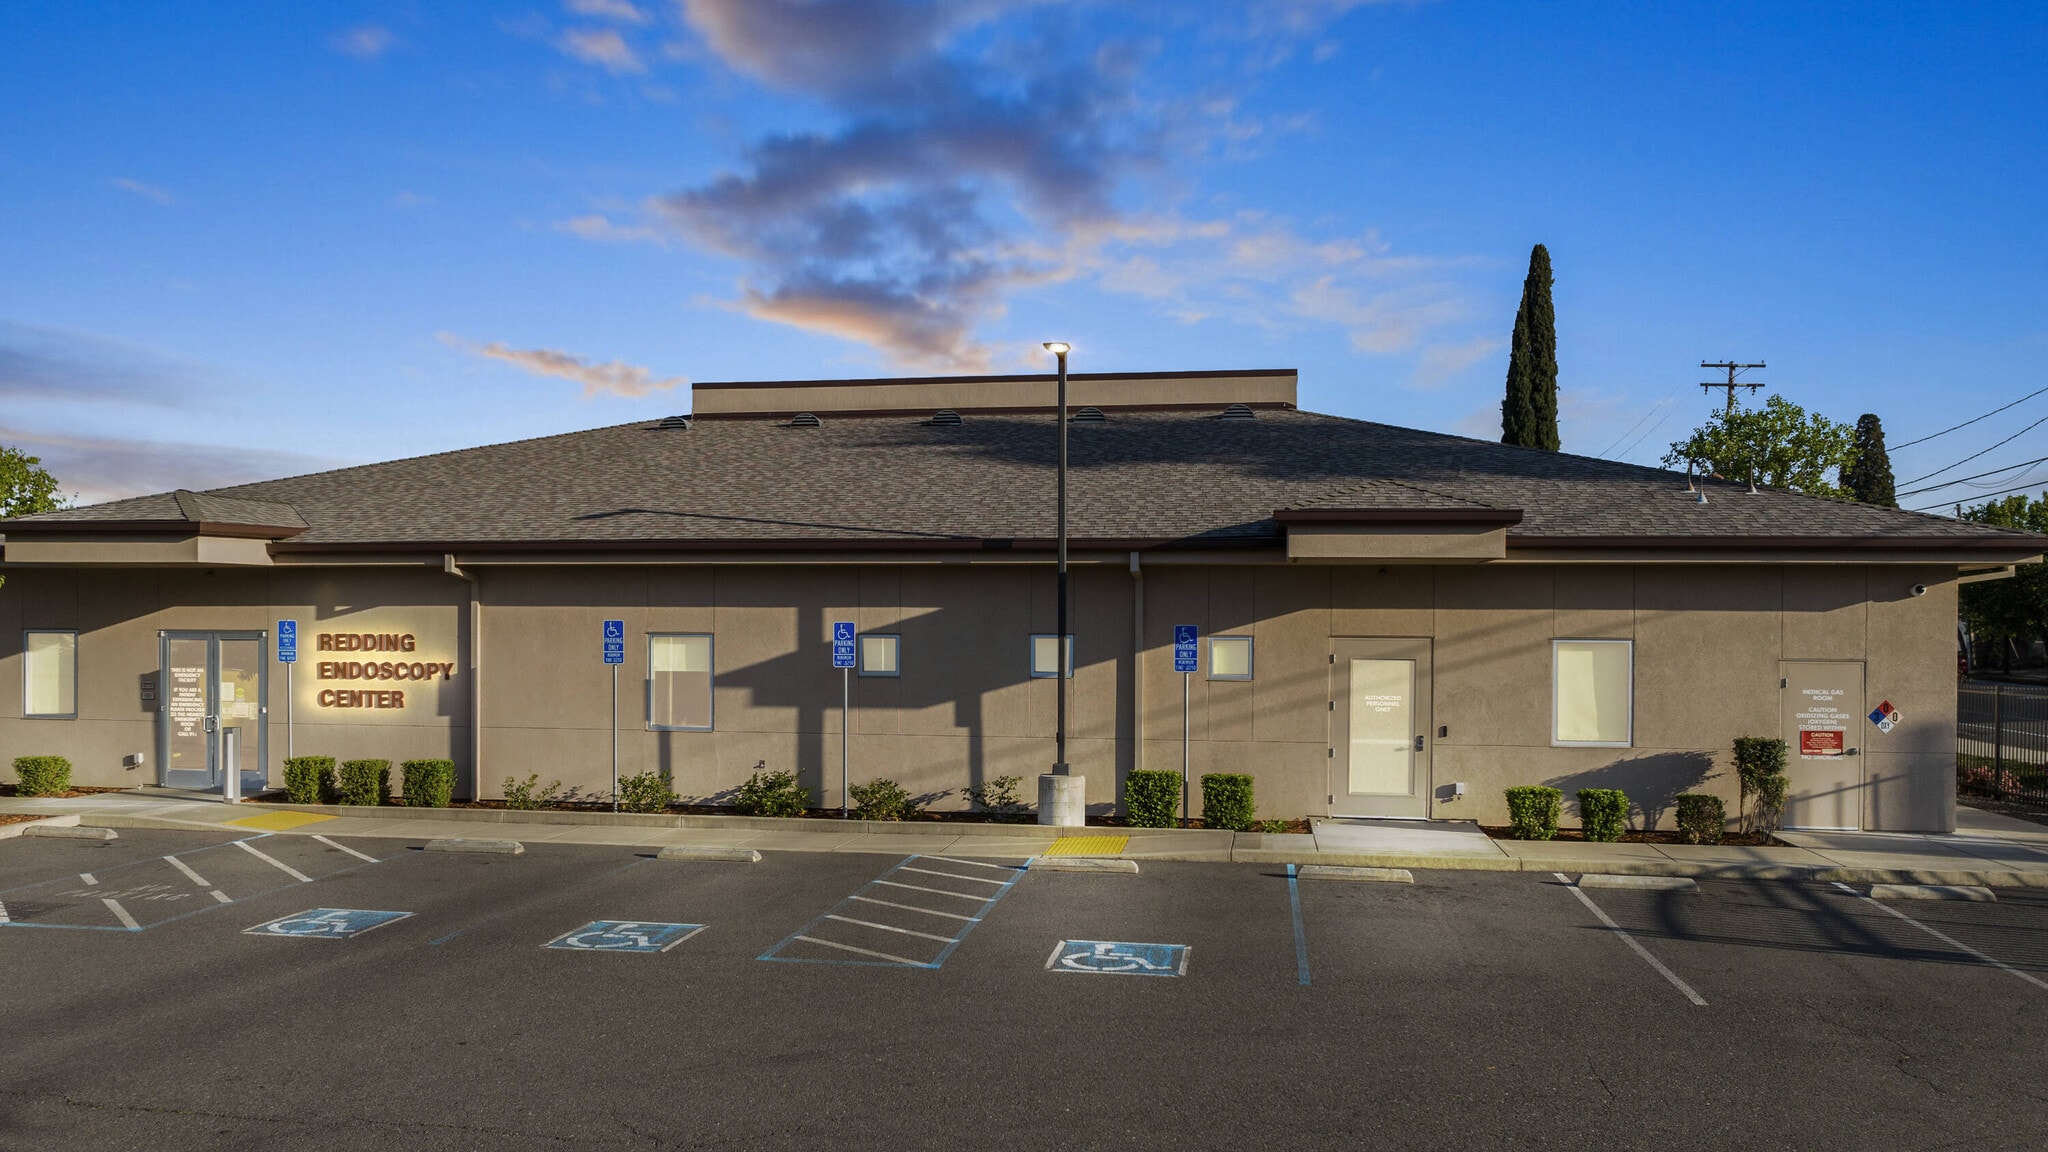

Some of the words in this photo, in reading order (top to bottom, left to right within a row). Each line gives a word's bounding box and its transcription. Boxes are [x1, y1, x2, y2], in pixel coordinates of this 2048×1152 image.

[317, 633, 416, 652] REDDING
[317, 661, 454, 680] ENDOSCOPY
[318, 689, 404, 708] CENTER
[1883, 703, 1889, 713] 0
[1874, 712, 1879, 721] 3
[1892, 712, 1898, 721] 0
